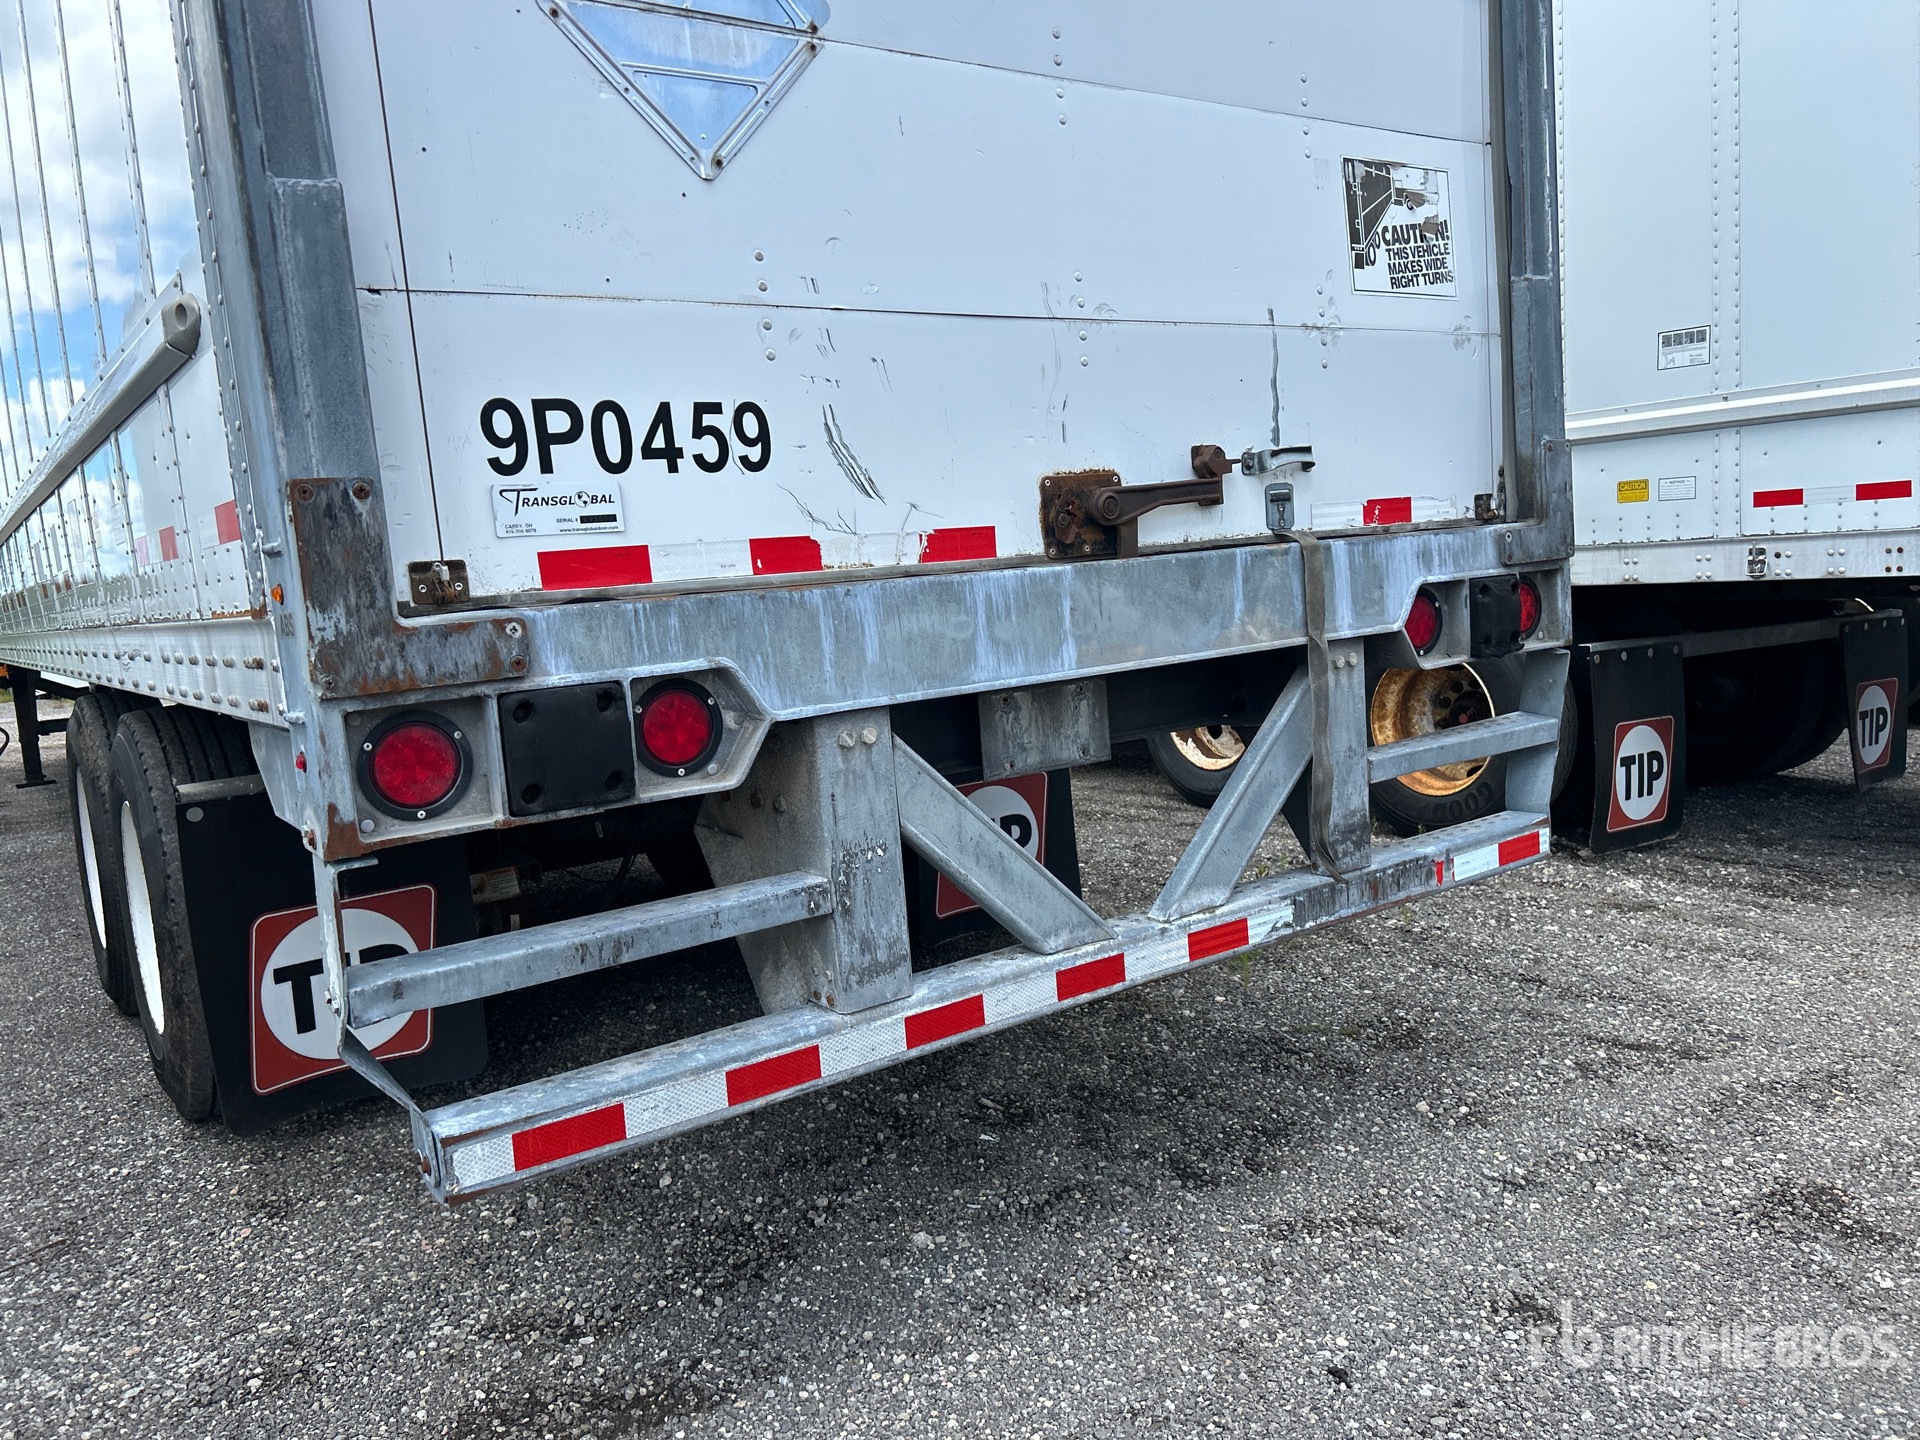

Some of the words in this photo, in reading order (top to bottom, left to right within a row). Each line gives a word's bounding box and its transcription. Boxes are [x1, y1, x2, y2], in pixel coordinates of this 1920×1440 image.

[1381, 219, 1449, 246] CAUTIN!
[1385, 247, 1409, 261] THIS
[1409, 243, 1450, 259] VEHICLE
[1387, 260, 1423, 276] MAKES
[1423, 257, 1445, 271] WIDE
[1390, 274, 1420, 289] RIGHT
[1422, 271, 1453, 286] TURNS
[480, 397, 771, 476] 9P0459
[1620, 482, 1646, 491] CAUTION
[280, 613, 295, 637] ABS
[1858, 706, 1888, 748] TIP
[1619, 750, 1664, 801] TIP
